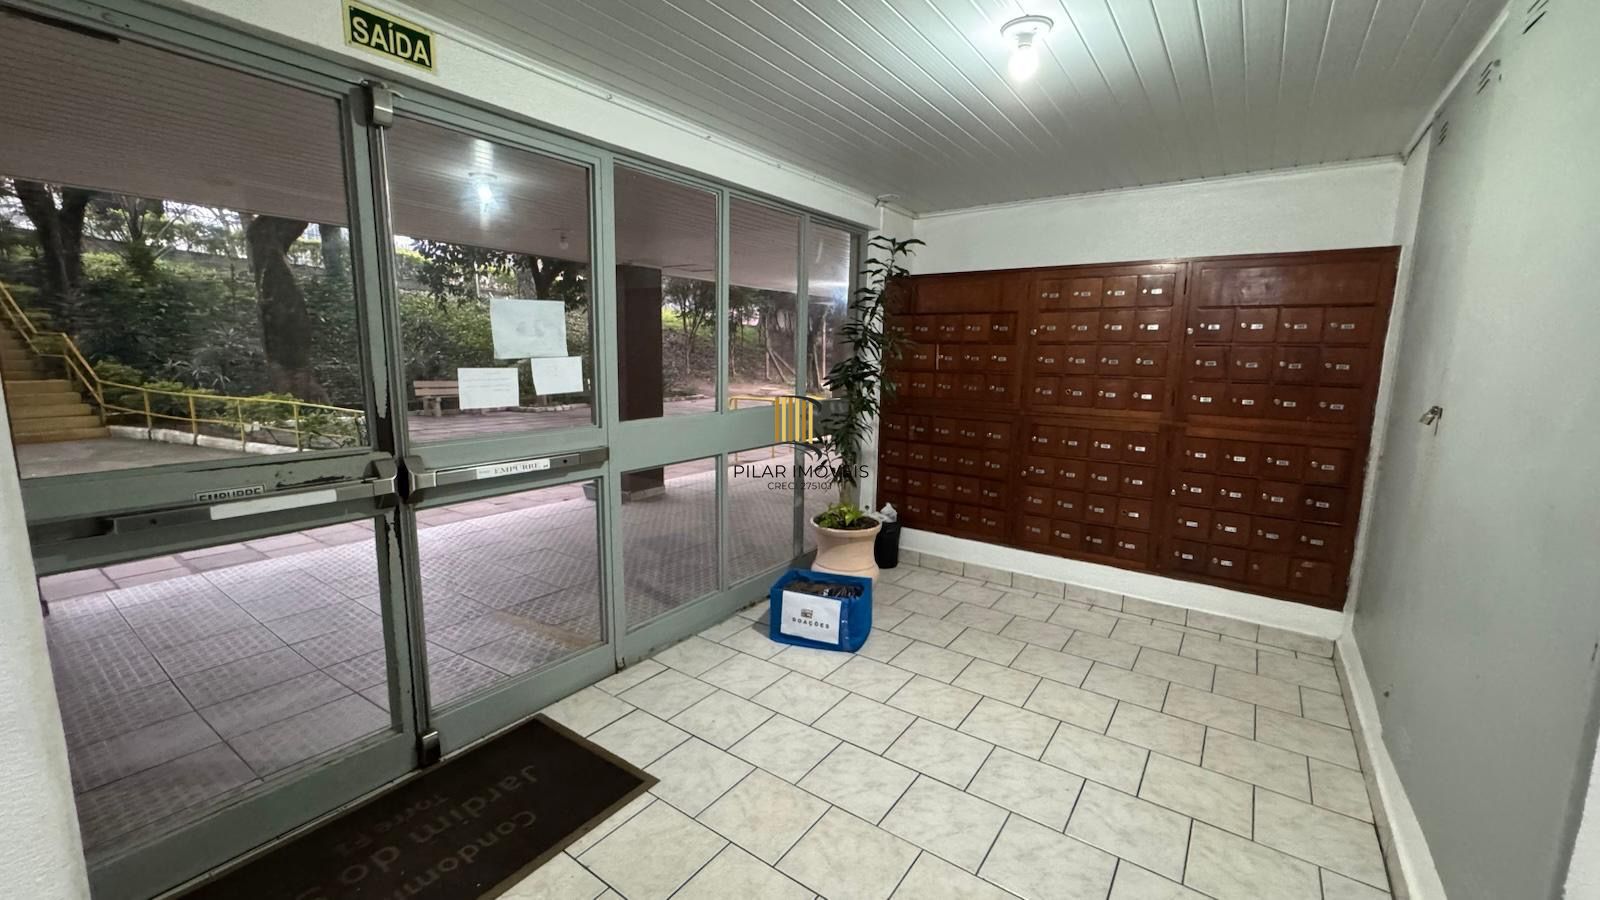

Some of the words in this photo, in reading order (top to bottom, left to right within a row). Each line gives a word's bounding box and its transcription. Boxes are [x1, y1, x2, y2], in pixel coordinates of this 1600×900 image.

[352, 16, 430, 66] SAÍDA
[408, 764, 537, 843] Jardim
[341, 845, 401, 884] do
